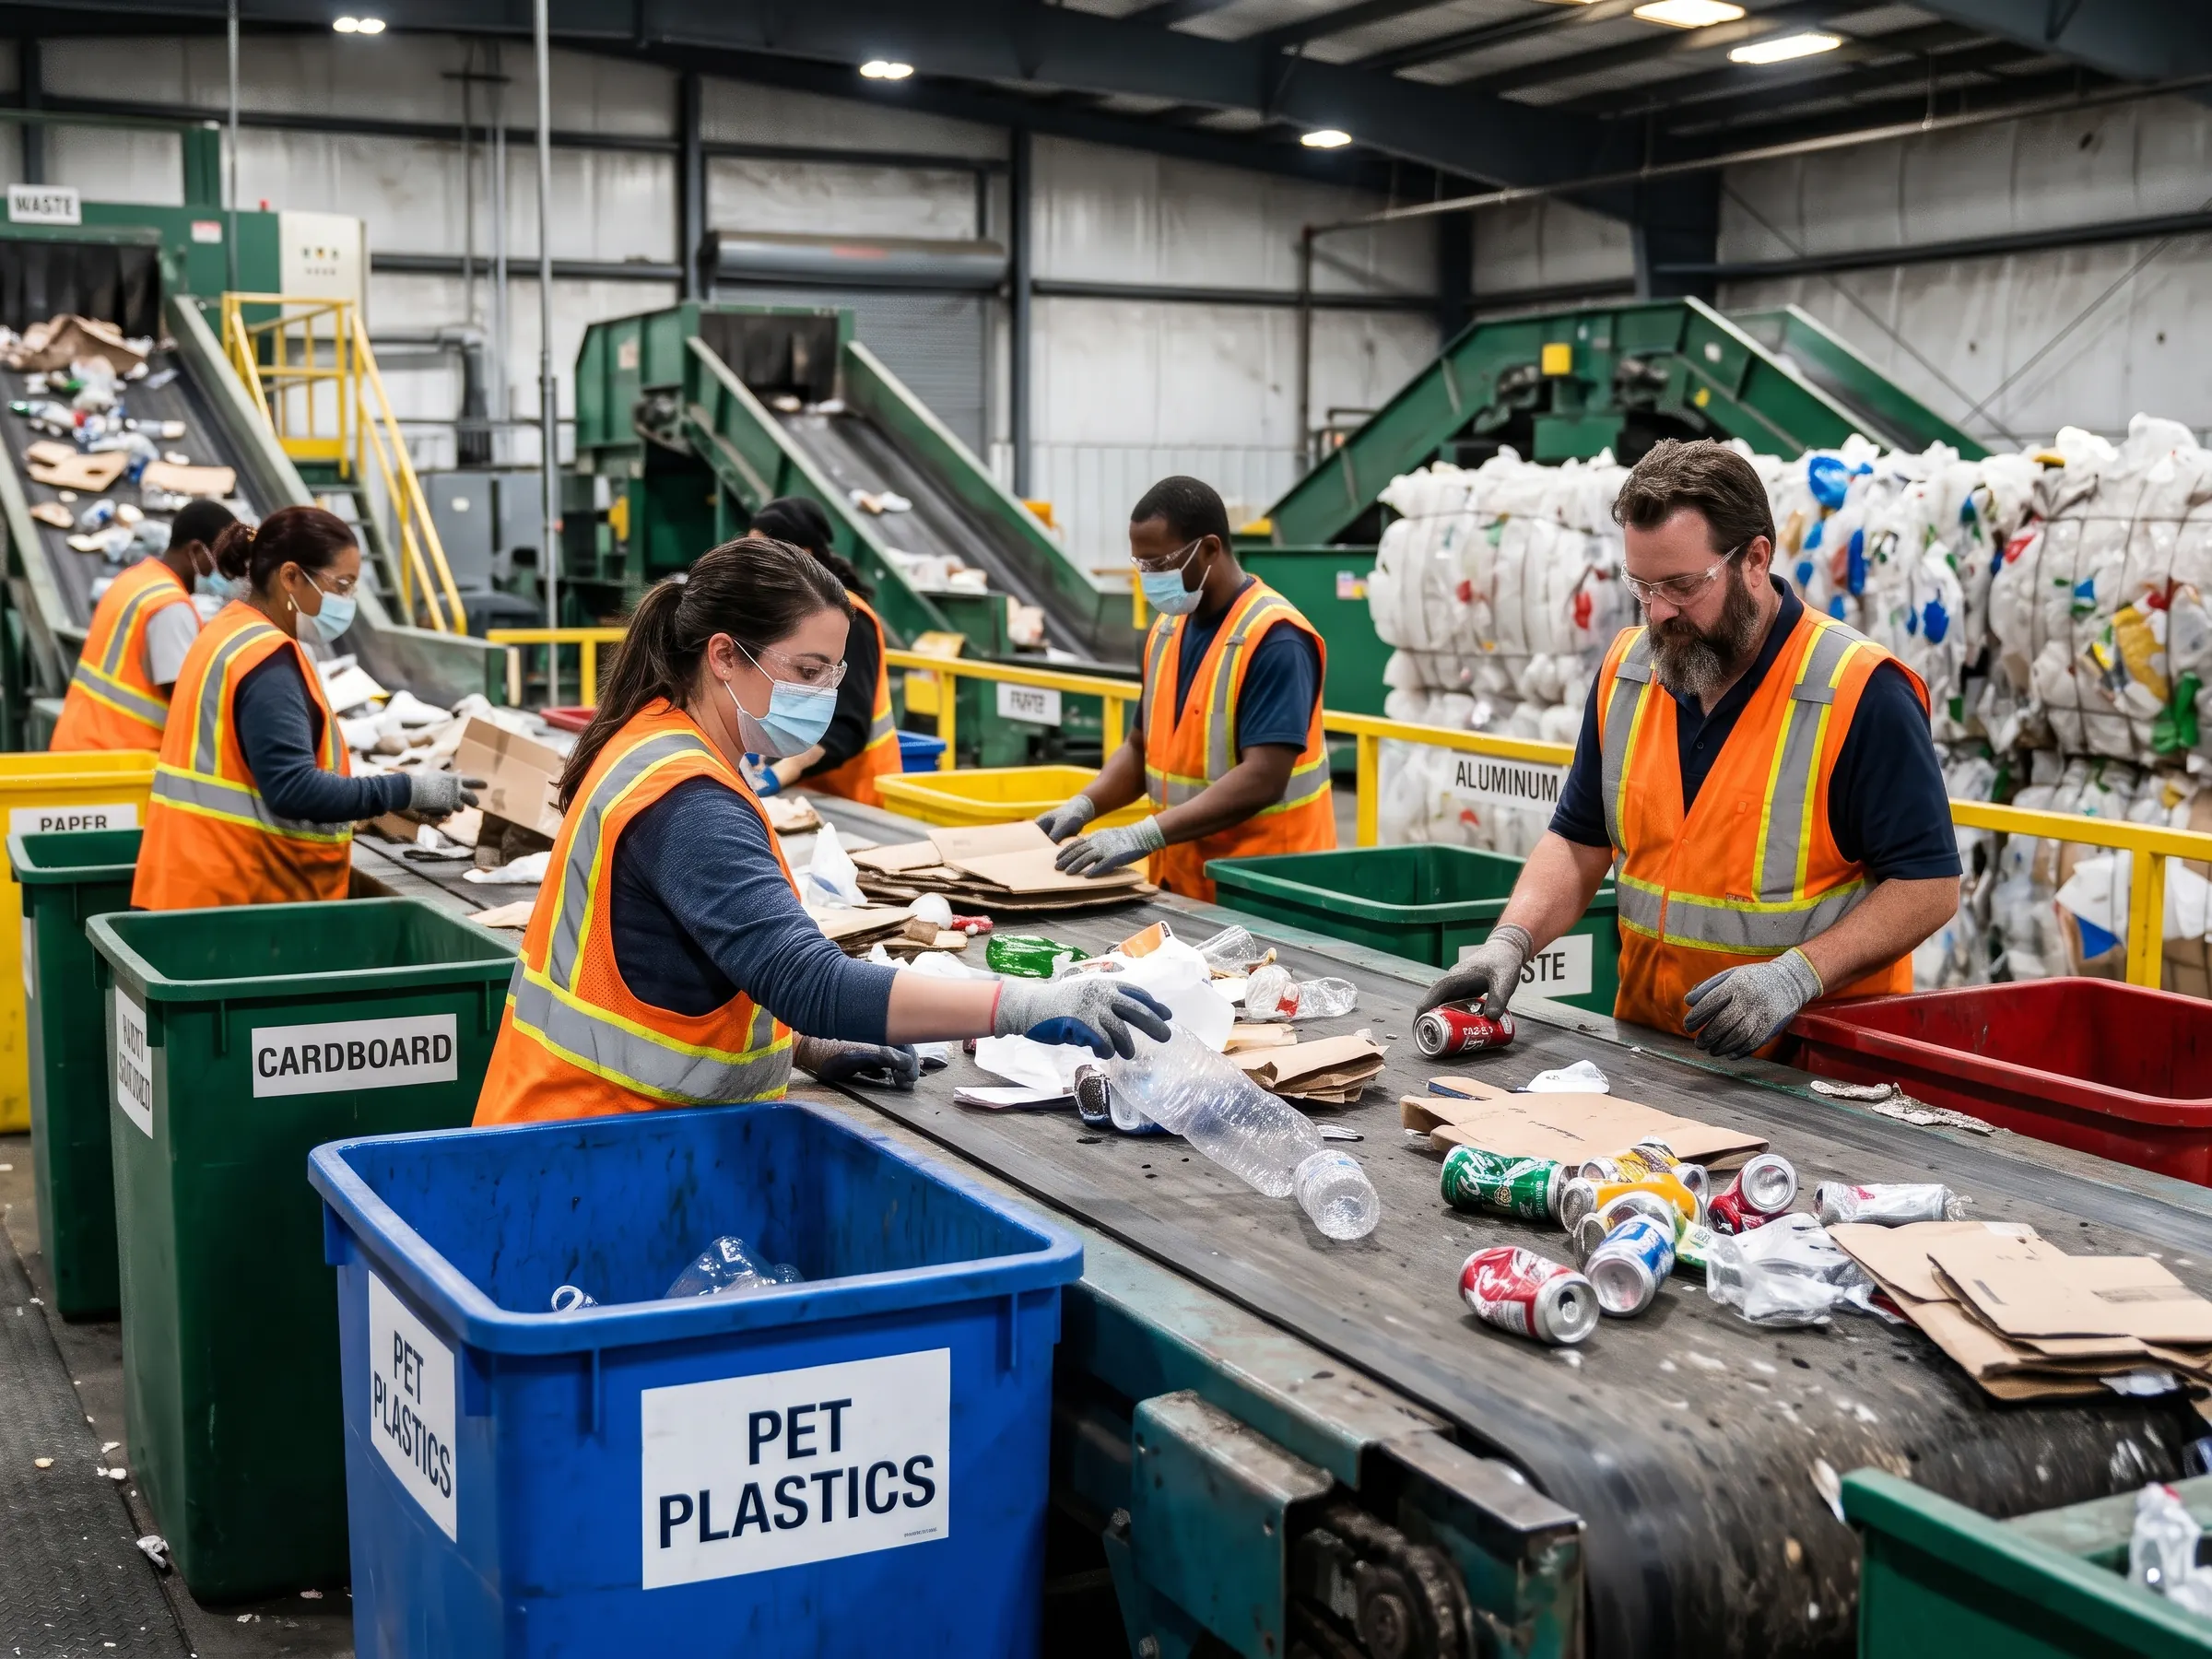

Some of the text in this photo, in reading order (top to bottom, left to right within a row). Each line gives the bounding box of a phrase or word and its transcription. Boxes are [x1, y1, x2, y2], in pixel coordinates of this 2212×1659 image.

[15, 194, 73, 217] WASTE
[1456, 760, 1558, 803] ALUMINUM
[41, 815, 107, 831] PAPER
[1521, 952, 1565, 983] STE
[258, 1034, 452, 1077] CARDBOARD
[394, 1330, 424, 1405] PET
[374, 1371, 451, 1499] PLASTICS
[748, 1397, 852, 1465] PET
[659, 1454, 935, 1548] PLASTICS
